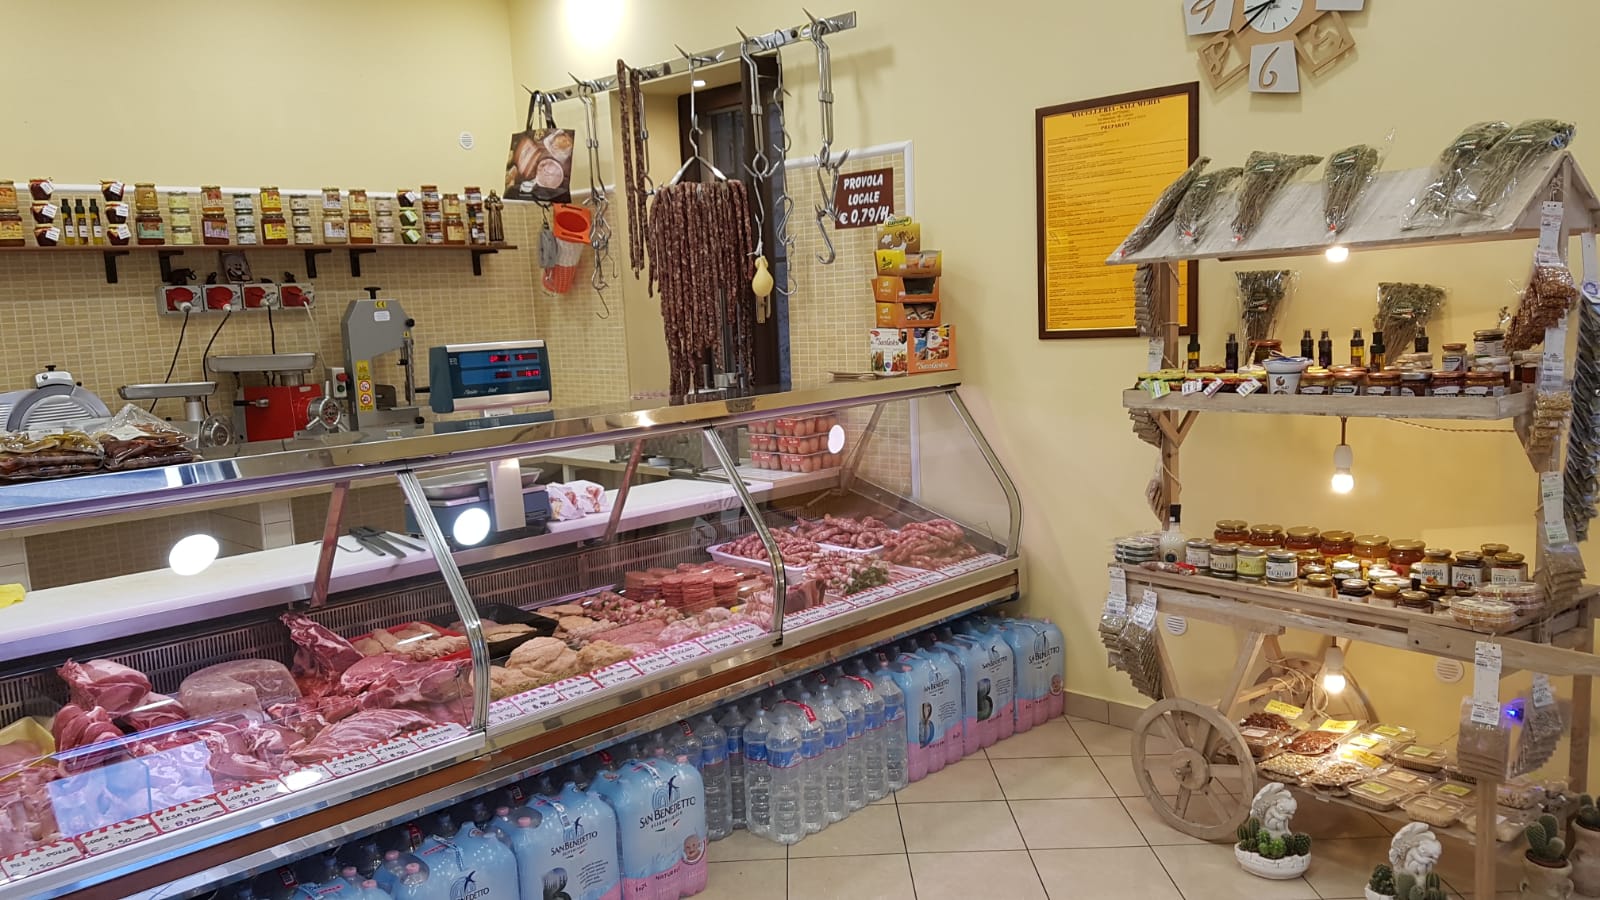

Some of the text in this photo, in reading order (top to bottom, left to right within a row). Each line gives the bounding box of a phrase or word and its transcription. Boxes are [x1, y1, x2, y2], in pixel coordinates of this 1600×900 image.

[1258, 46, 1279, 89] 6
[1100, 121, 1130, 131] PREPARATI
[843, 173, 884, 191] PROVOLA
[847, 190, 881, 206] LOCALE
[839, 212, 849, 225] €
[640, 813, 654, 829] SAN
[653, 796, 697, 821] BENEDETTO
[550, 844, 565, 857] SAN
[564, 830, 598, 850] BENEDETTO
